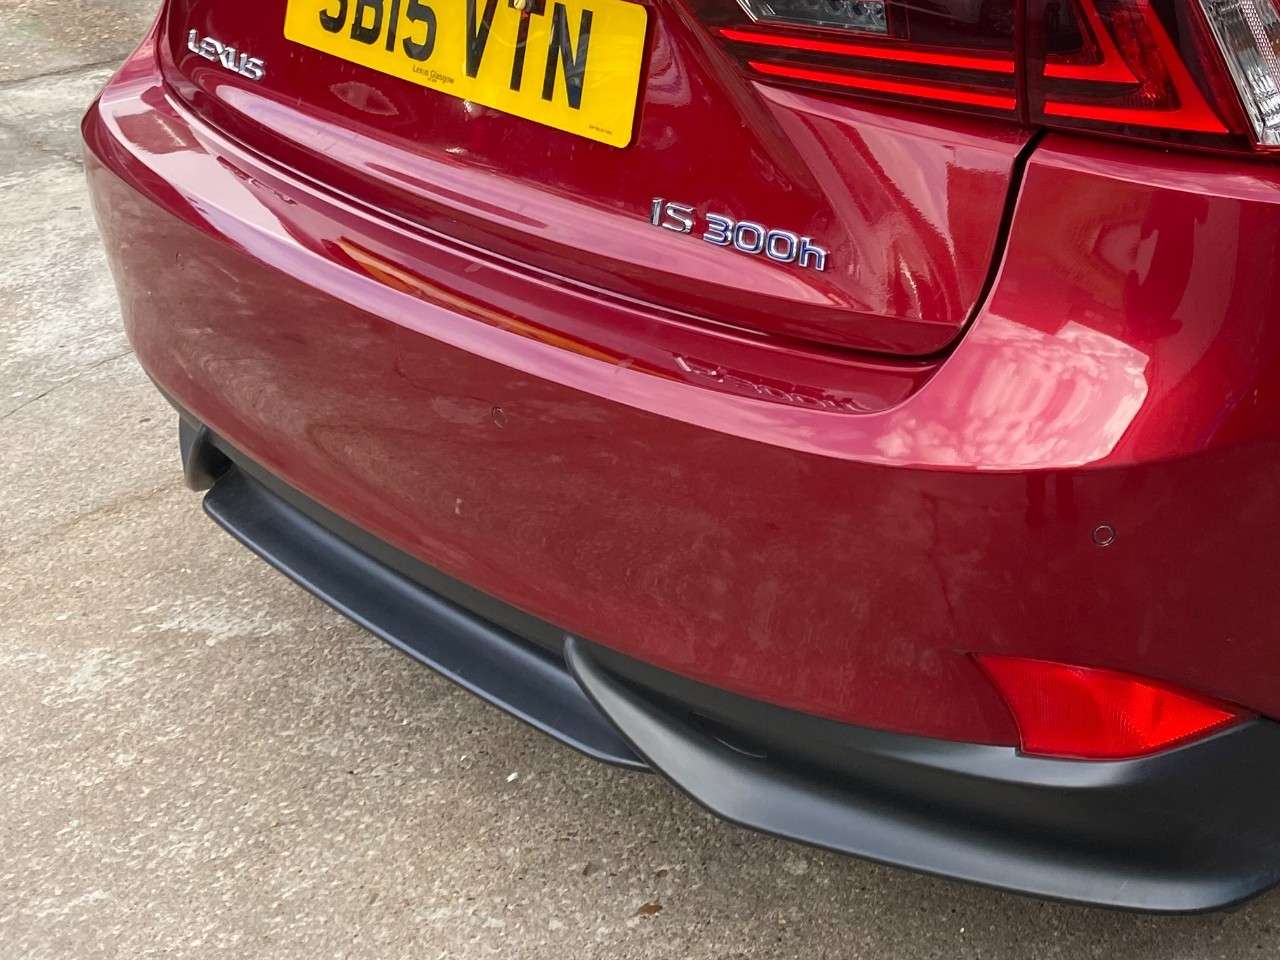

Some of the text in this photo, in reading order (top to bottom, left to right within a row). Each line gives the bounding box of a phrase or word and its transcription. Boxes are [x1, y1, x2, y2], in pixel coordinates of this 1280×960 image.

[188, 28, 265, 80] LEXUS
[650, 196, 830, 272] IS 300h
